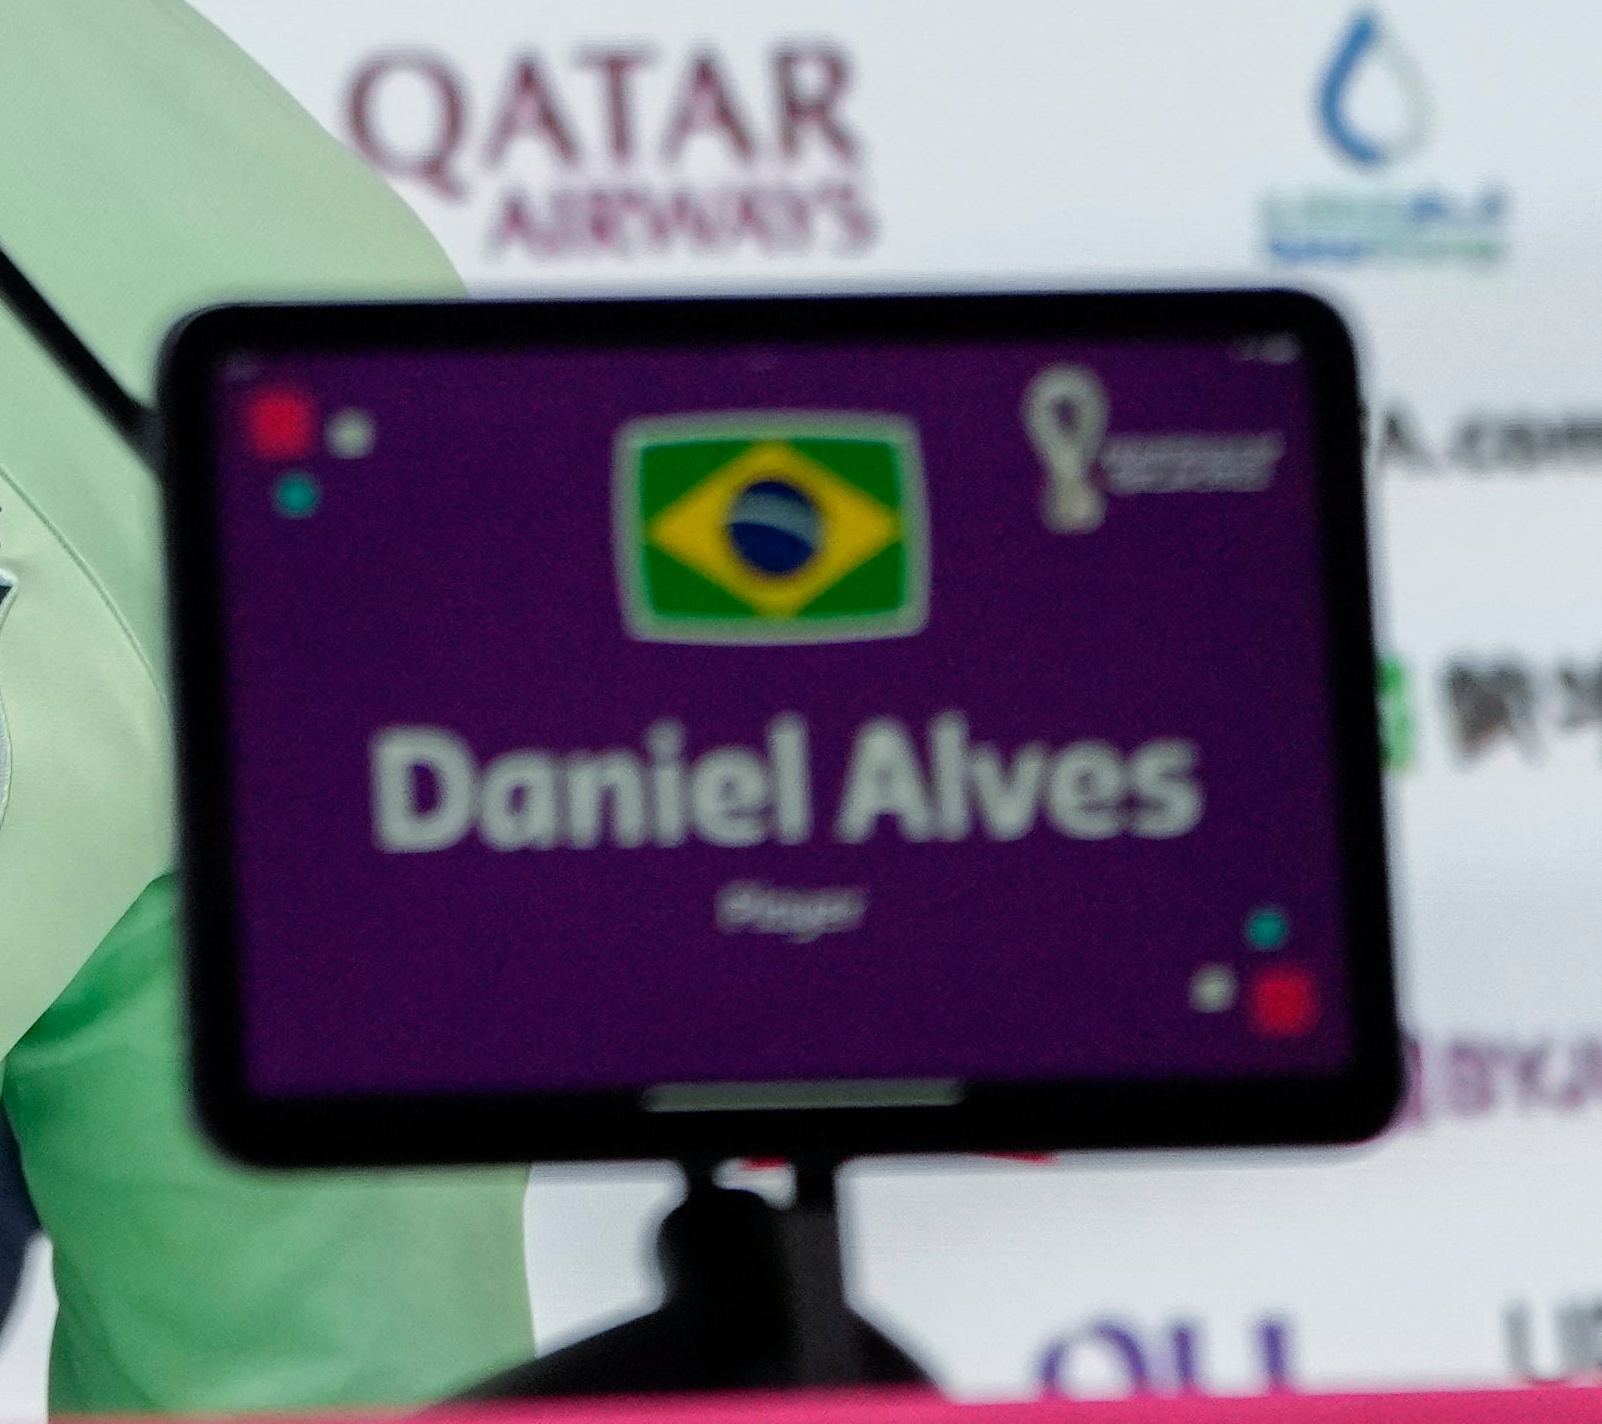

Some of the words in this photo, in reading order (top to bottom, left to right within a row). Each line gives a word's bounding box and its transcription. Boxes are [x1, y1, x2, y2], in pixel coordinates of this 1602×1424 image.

[338, 35, 868, 207] QATAR
[486, 181, 882, 259] AIRWAYS
[368, 713, 814, 853] Daniel
[834, 711, 1206, 845] Alves
